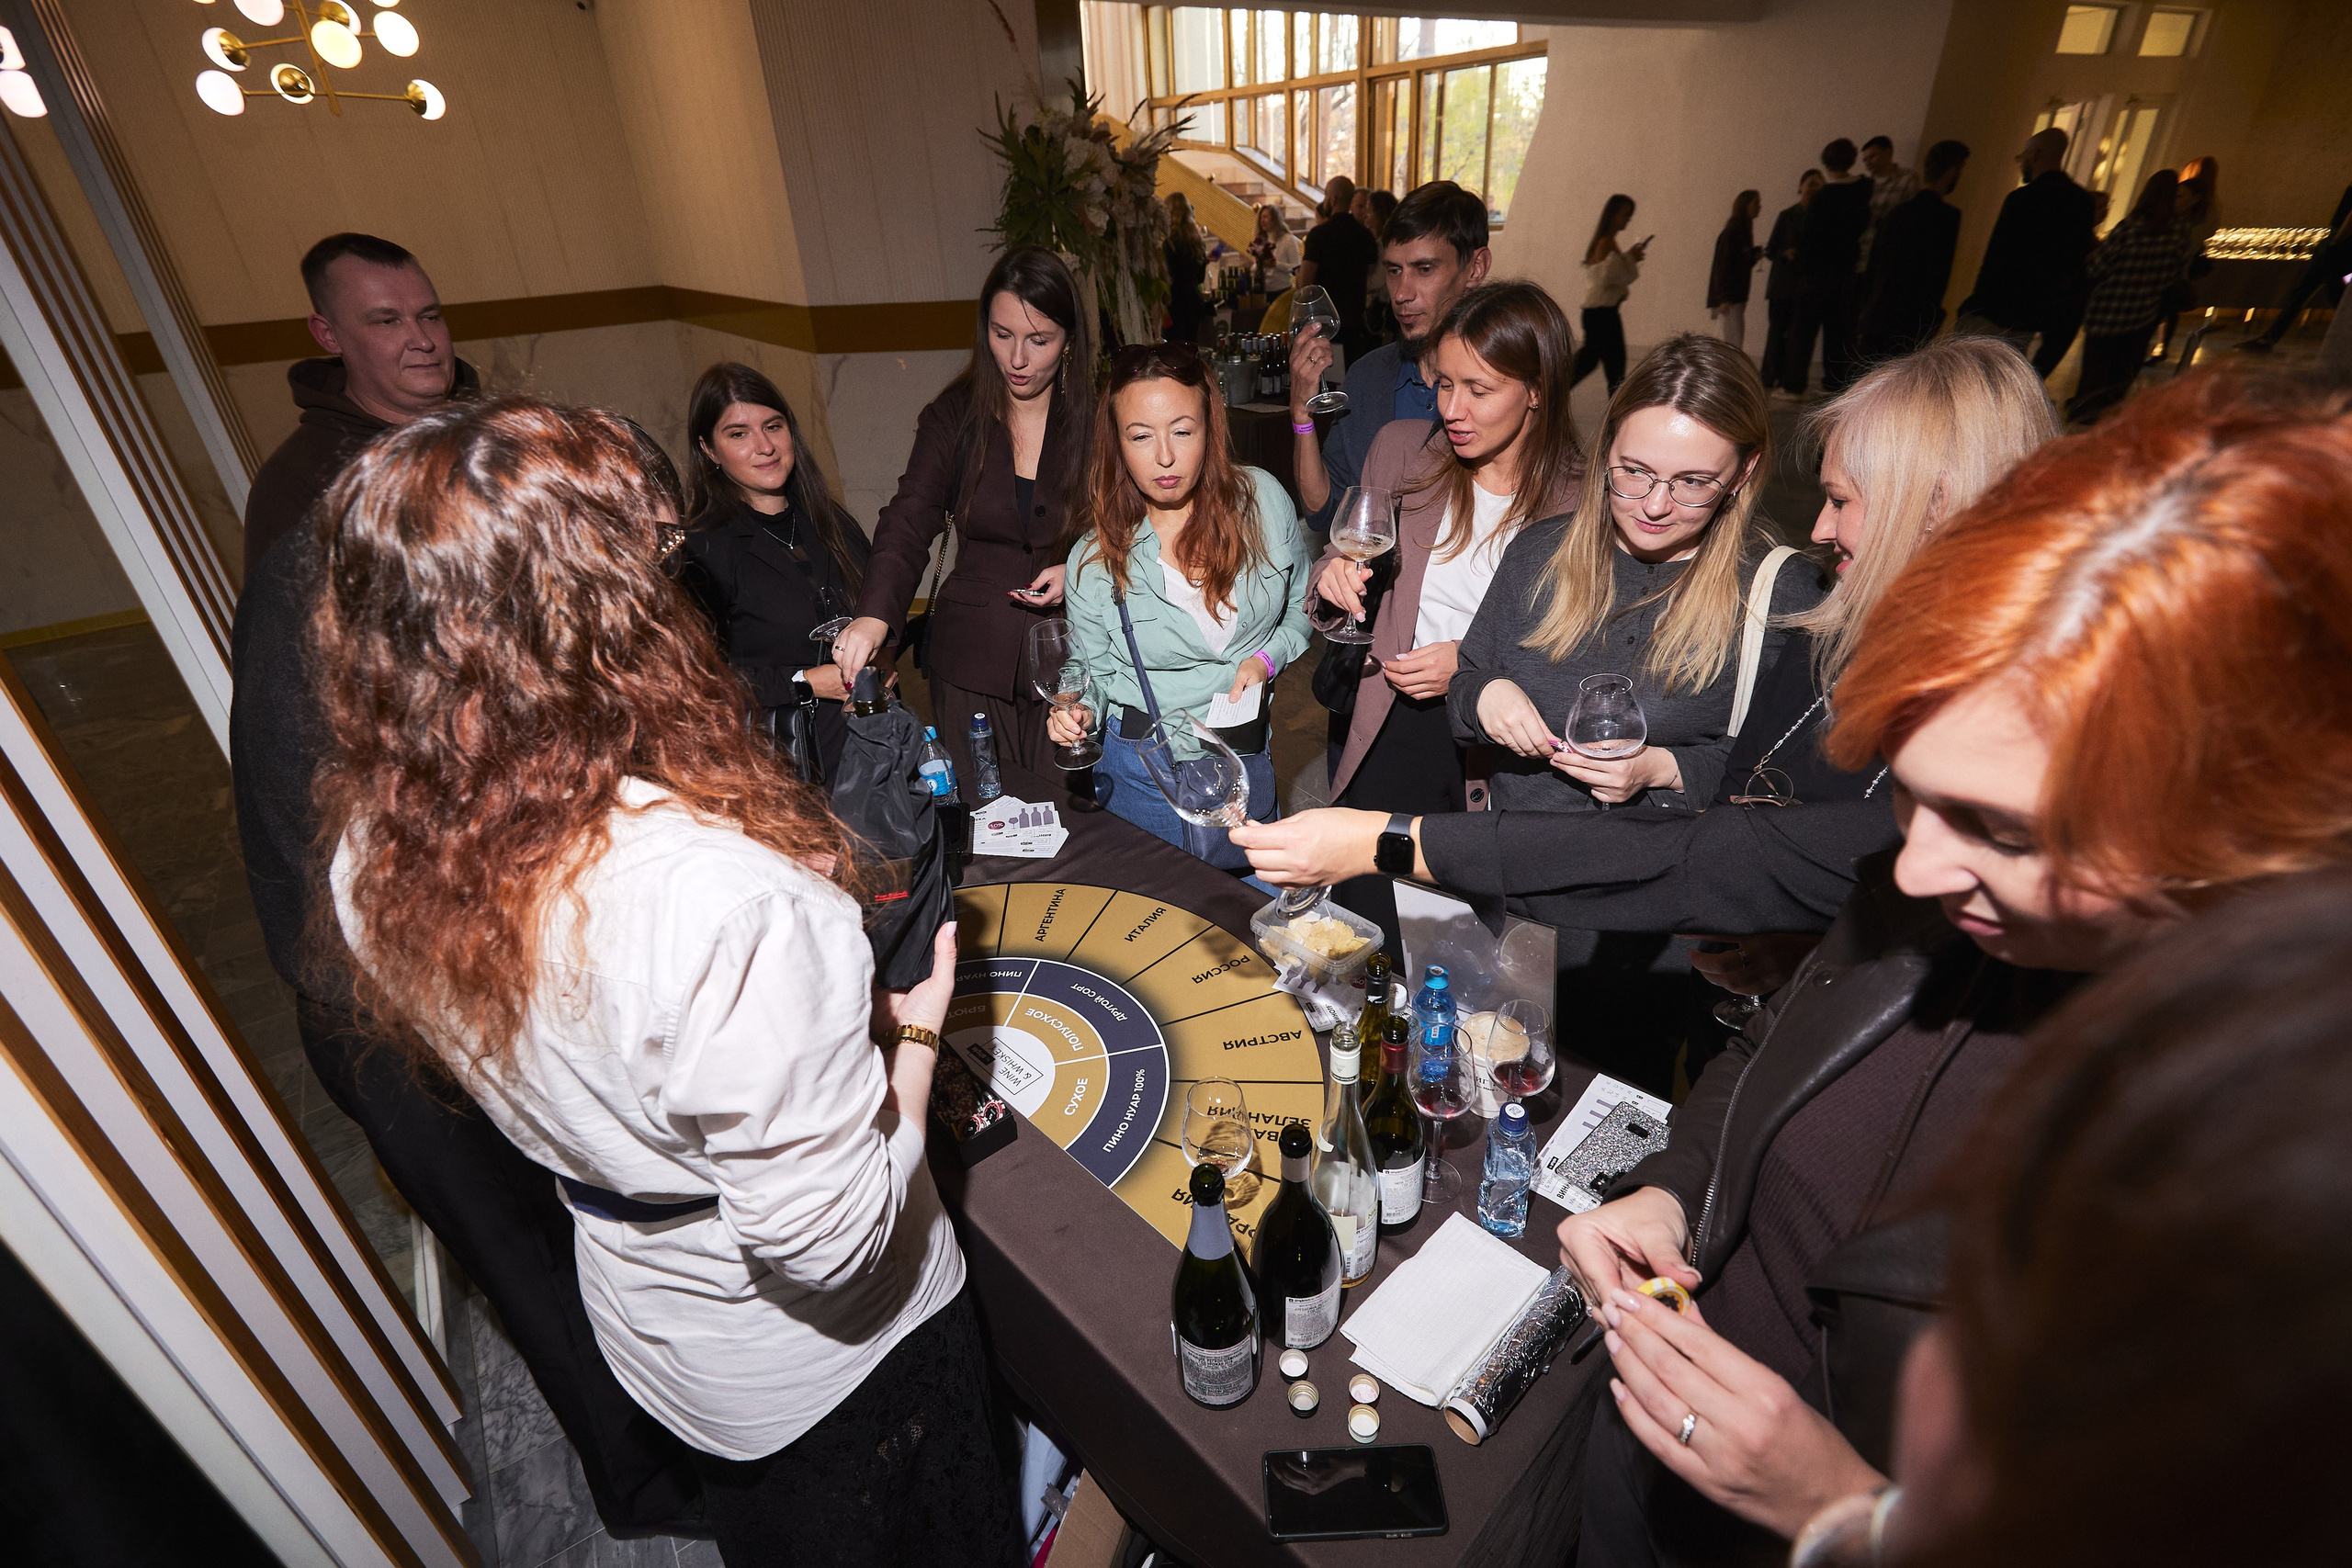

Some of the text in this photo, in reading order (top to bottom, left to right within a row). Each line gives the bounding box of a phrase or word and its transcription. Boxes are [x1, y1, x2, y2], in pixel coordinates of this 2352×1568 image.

[1035, 887, 1067, 942] АРГЕНТИНА
[1124, 907, 1167, 942] ИТАЛИЯ
[956, 970, 1023, 982] ПИНО НУАР
[1192, 954, 1250, 984] РОССИЯ
[946, 1004, 986, 1020] БРЮТ
[1069, 983, 1128, 1022] ДРУГОЙ СОРТ
[1024, 1008, 1084, 1052] ПОЛУСУХОЕ
[1222, 1030, 1302, 1050] АВСТРИЯ
[989, 1043, 1033, 1080] & WHISKEY
[998, 1066, 1022, 1087] WINE
[1064, 1077, 1088, 1116] СУХОЕ
[1102, 1068, 1146, 1153] ПИНО НУАР 100%
